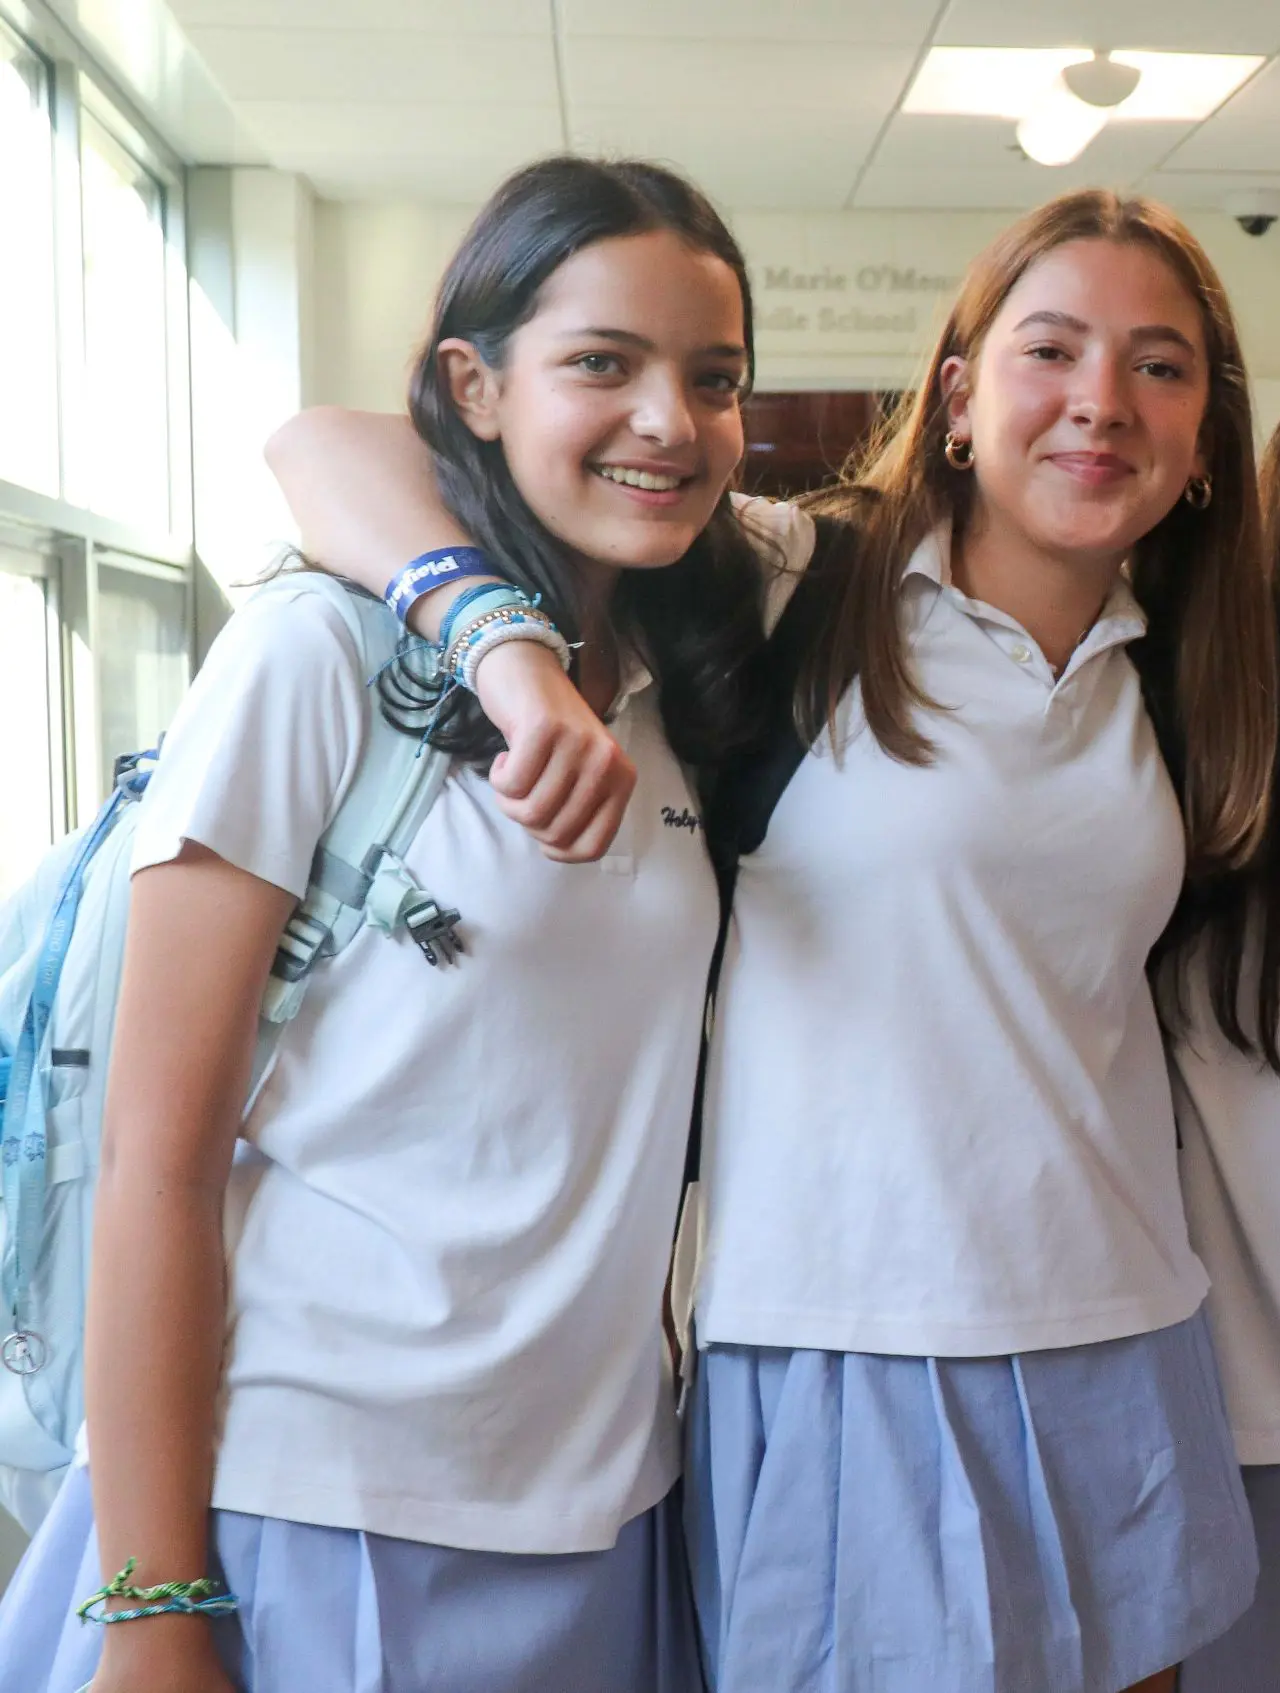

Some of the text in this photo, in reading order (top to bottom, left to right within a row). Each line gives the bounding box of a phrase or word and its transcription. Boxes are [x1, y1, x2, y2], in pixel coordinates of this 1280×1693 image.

[764, 264, 847, 290] Marie
[819, 306, 916, 333] School
[661, 806, 698, 835] Holy
